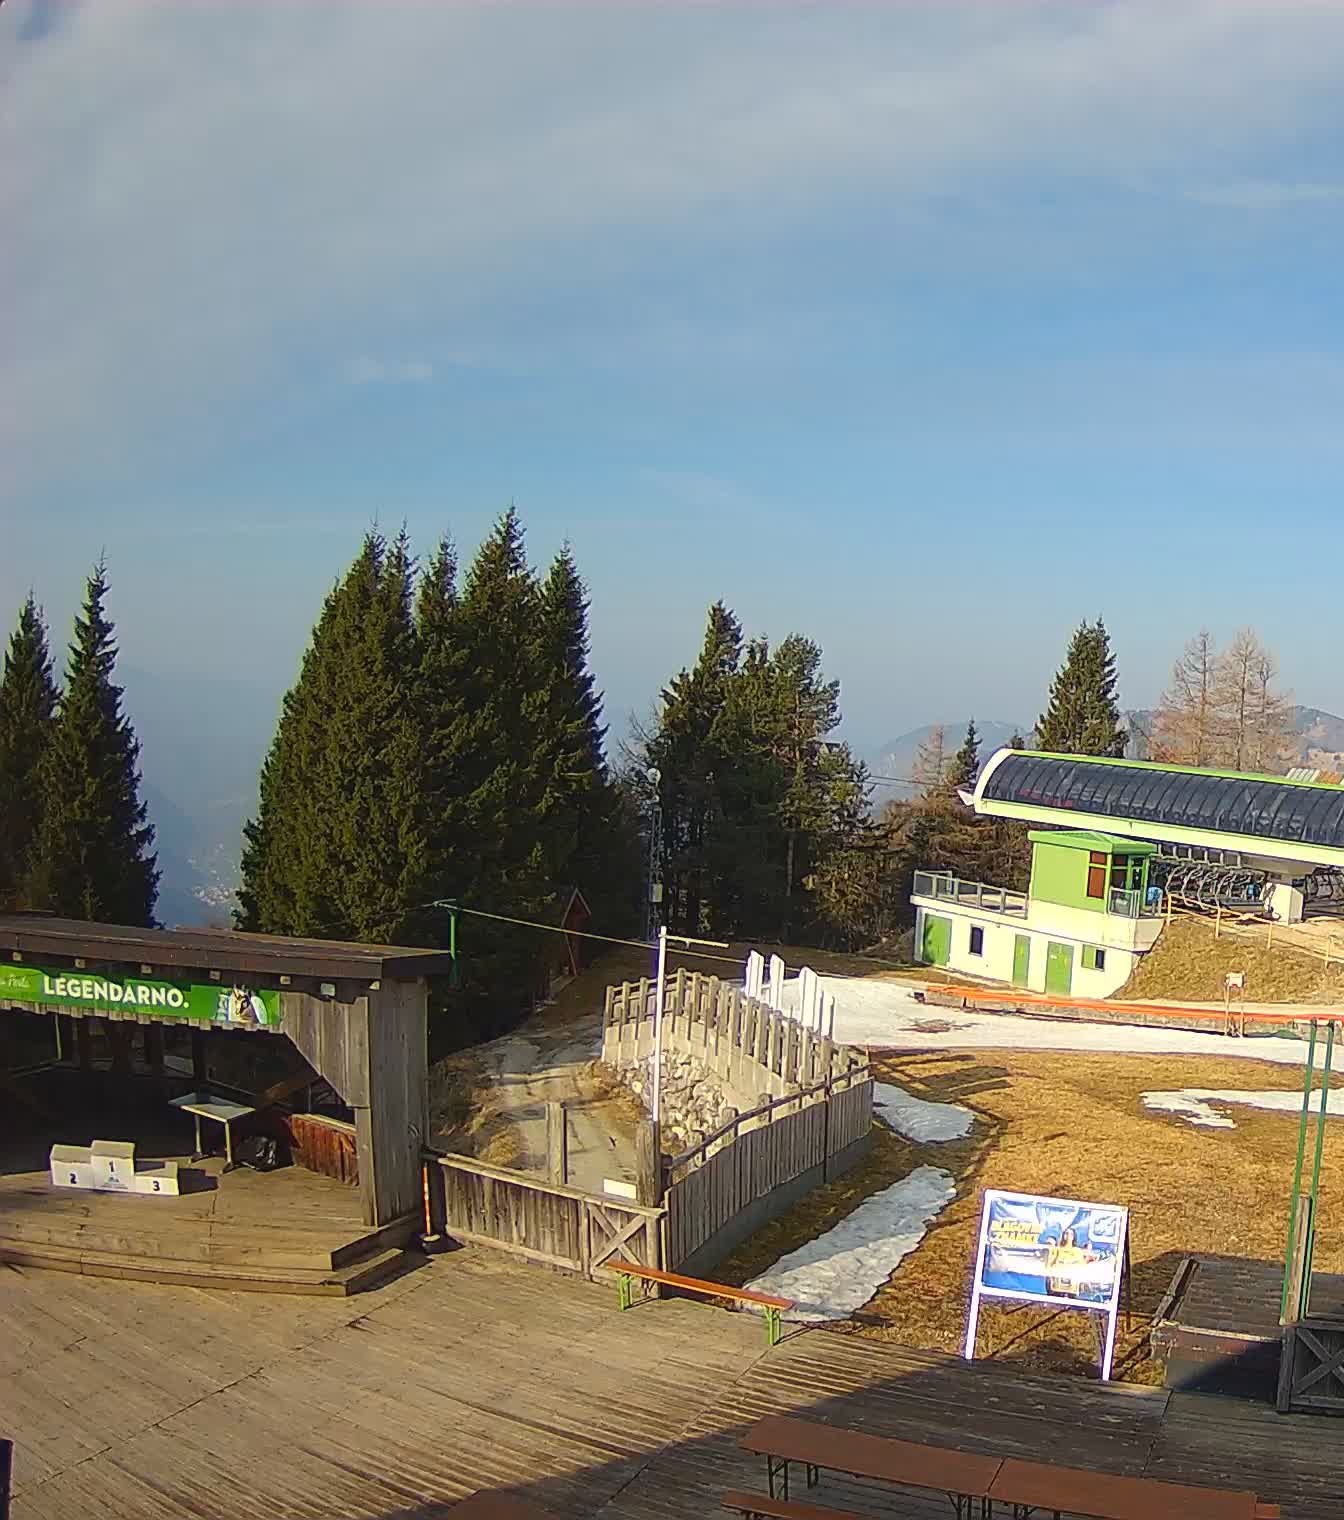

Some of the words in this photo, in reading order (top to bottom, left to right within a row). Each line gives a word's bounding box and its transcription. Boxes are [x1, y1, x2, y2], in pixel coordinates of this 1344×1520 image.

[43, 975, 190, 1009] LEGENDARNO.
[108, 1160, 115, 1173] 1
[69, 1173, 77, 1185] 2
[152, 1180, 161, 1192] 3
